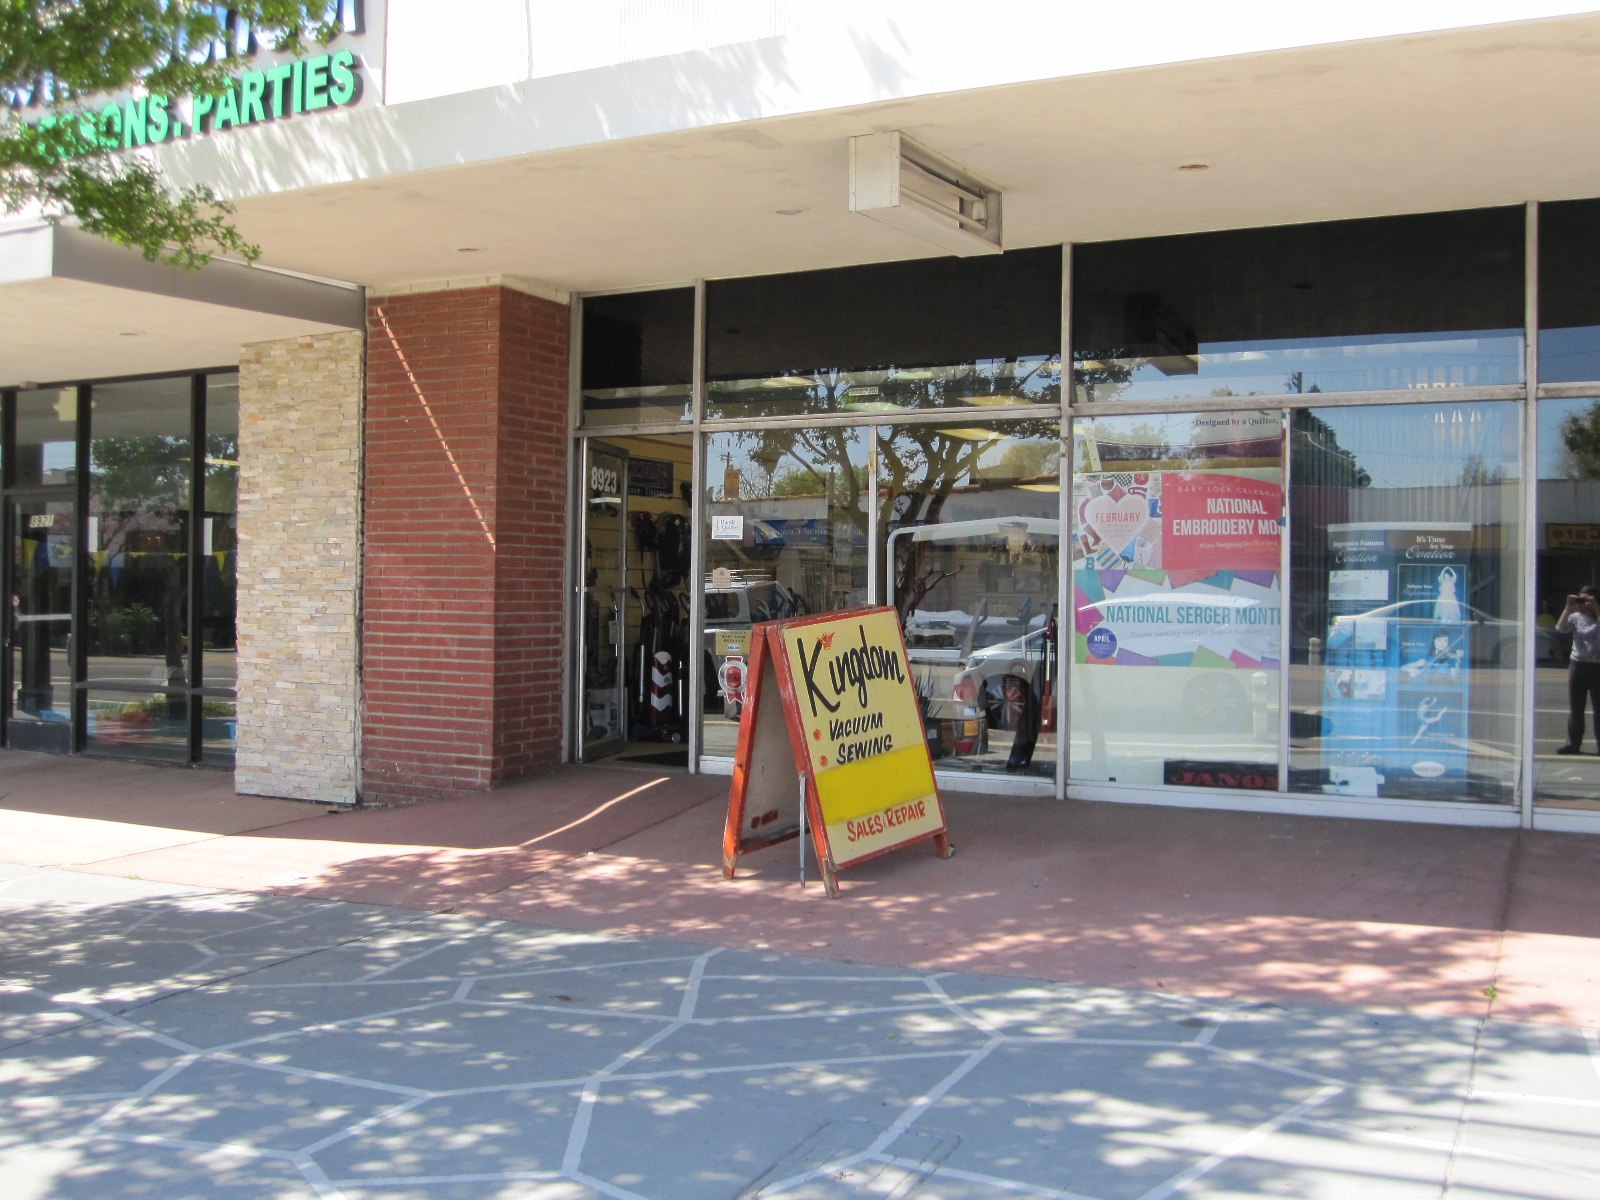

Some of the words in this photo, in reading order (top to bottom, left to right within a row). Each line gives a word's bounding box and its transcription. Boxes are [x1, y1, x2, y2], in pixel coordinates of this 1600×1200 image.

[193, 48, 356, 133] PARTIES
[1196, 418, 1230, 428] Designed
[1231, 417, 1240, 427] by
[591, 466, 618, 494] 8923
[1207, 498, 1268, 515] NATIONAL
[1096, 512, 1141, 523] FEBRUARY
[1173, 519, 1255, 536] EMBROIDERY
[1333, 540, 1360, 549] Impressive
[1360, 539, 1385, 547] Features
[1405, 545, 1456, 559] Ovation
[1106, 605, 1173, 624] NATIONAL
[1176, 606, 1231, 625] SERGER
[797, 624, 905, 717] Kingdom
[829, 712, 883, 741] VACUUM
[836, 734, 893, 765] SEWING
[847, 816, 884, 842] SALES
[885, 800, 926, 828] REPAIR
